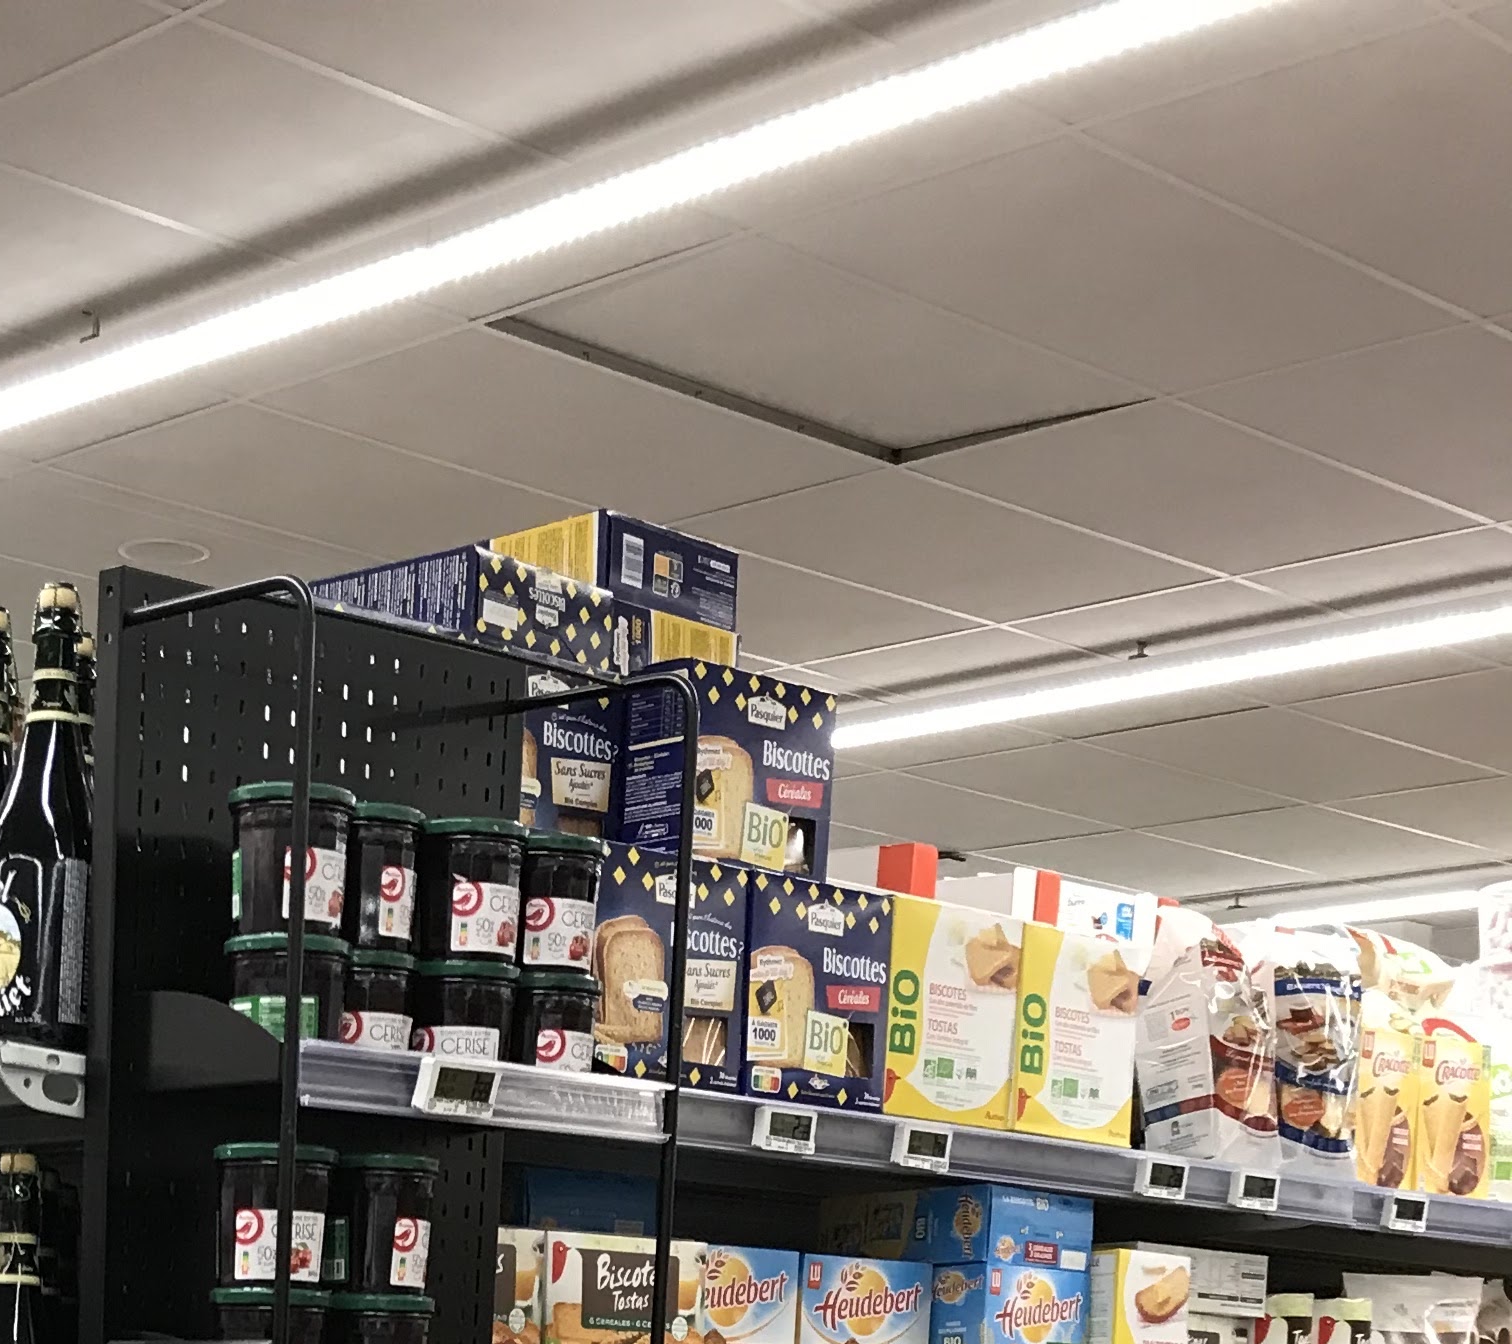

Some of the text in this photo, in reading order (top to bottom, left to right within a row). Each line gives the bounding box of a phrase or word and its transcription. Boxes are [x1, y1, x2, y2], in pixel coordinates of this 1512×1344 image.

[750, 706, 784, 726] Pasquier
[554, 761, 607, 781] Sans Sucres
[762, 739, 831, 781] Biscottes
[810, 911, 844, 932] Pasquier
[823, 946, 887, 985] Biscottes
[929, 982, 968, 1001] BISCOTES
[928, 1018, 959, 1035] TOSTAS
[613, 1290, 650, 1312] Tostas
[703, 1271, 788, 1311] eudebert
[814, 1283, 924, 1331] Heudebert
[995, 1292, 1084, 1340] Heudebert
